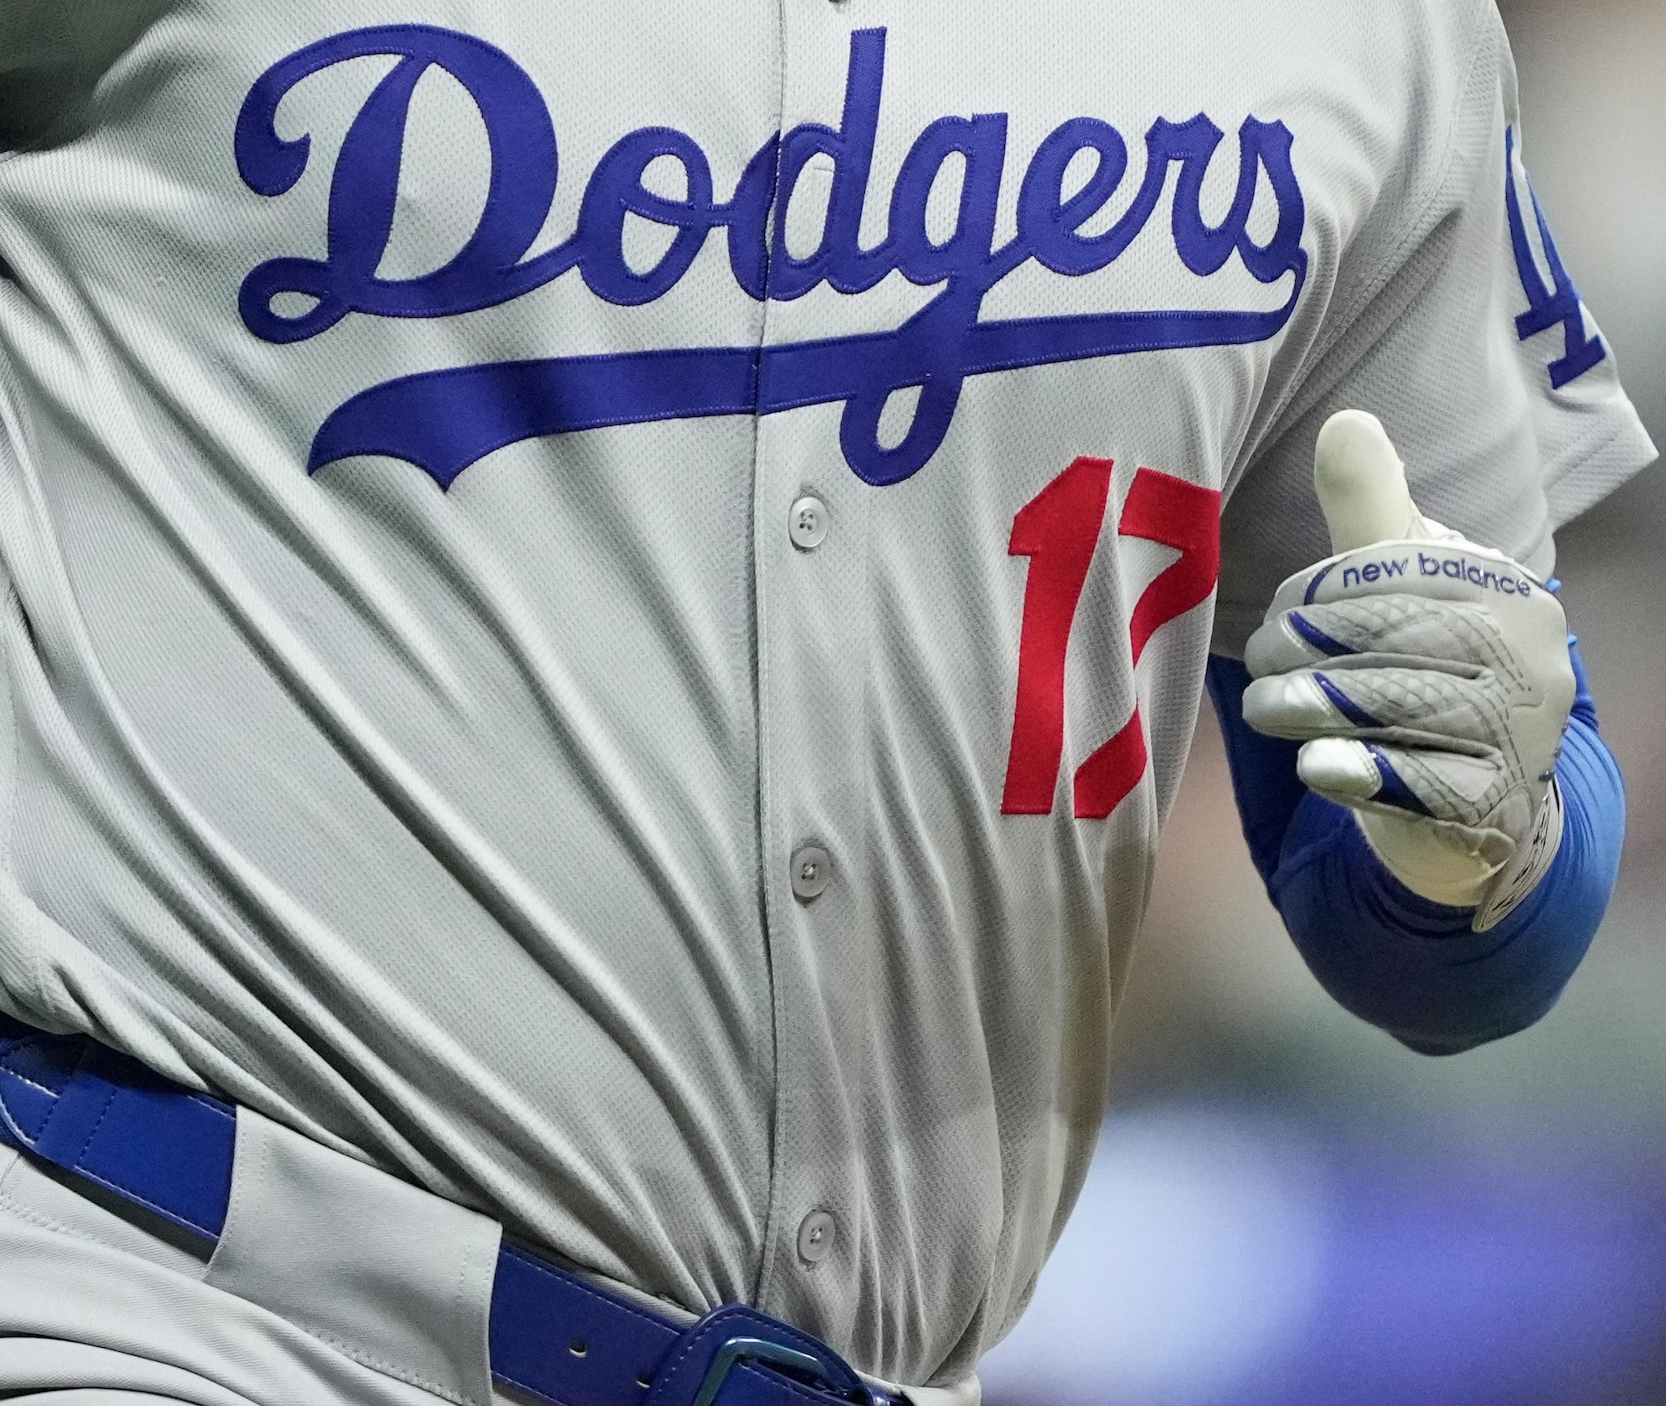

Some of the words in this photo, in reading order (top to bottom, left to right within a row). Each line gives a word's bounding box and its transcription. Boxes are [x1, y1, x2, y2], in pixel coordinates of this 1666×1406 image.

[234, 23, 1307, 489] Dodgers
[1000, 455, 1222, 820] 17
[1342, 557, 1409, 589] new
[1417, 551, 1532, 597] balance
